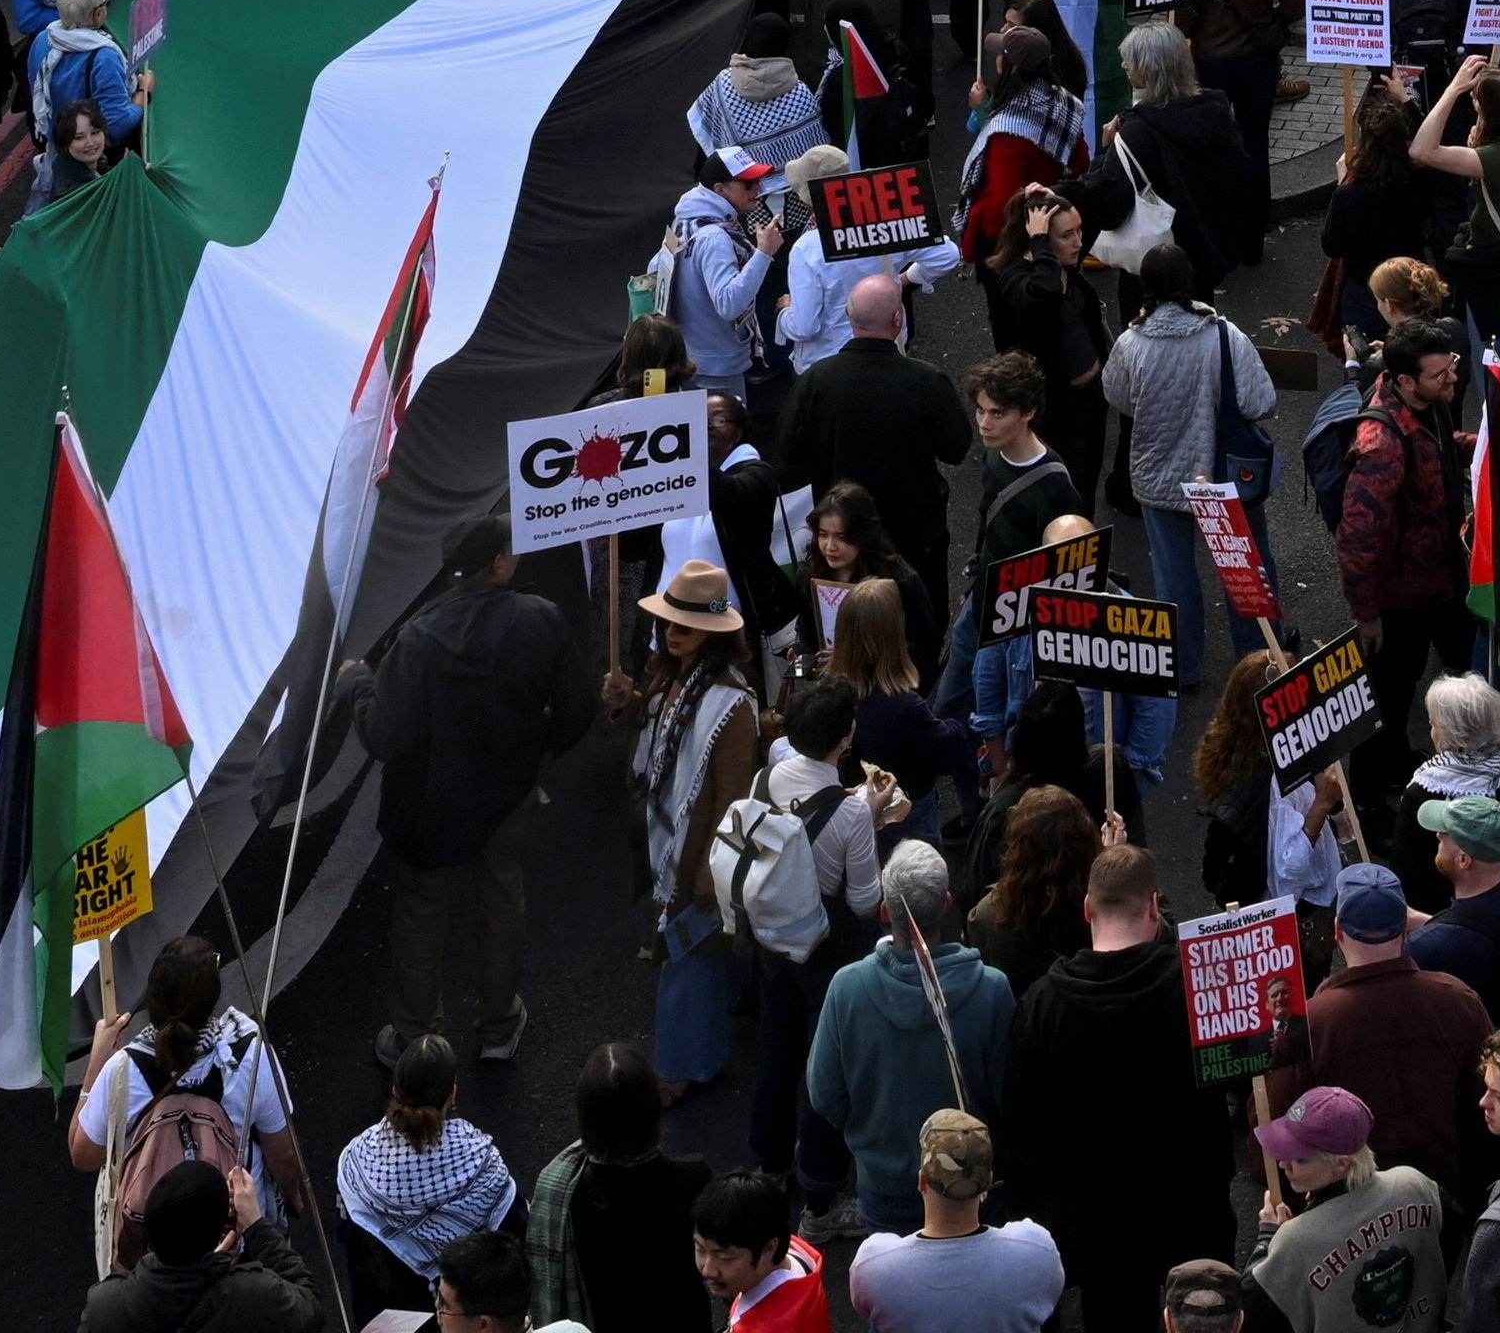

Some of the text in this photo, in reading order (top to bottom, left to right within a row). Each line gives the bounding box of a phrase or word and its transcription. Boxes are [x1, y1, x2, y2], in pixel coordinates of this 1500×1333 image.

[1313, 24, 1332, 34] FIGHT
[1367, 27, 1384, 38] WAR
[1320, 36, 1355, 48] AUSTERITY
[1356, 38, 1384, 50] AGENDA
[1312, 49, 1383, 61] socialistparty.org.uk
[823, 167, 926, 227] FREE
[832, 215, 930, 251] PALESTINE
[520, 422, 691, 489] Gza
[524, 474, 697, 521] Stop the genocide
[579, 519, 612, 531] Coalition
[1035, 596, 1172, 639] STOP GAZA
[1037, 630, 1174, 677] GENOCIDE
[78, 897, 138, 929] Islamophobia
[1187, 925, 1274, 967] STARMER
[1191, 944, 1296, 991] HAS BLOOD
[1194, 983, 1260, 1015] ON HIS
[1196, 1008, 1262, 1041] HANDS
[1200, 1045, 1233, 1063] FREE
[1201, 1052, 1272, 1081] PALESTINE
[1308, 1203, 1434, 1295] CHAMPION
